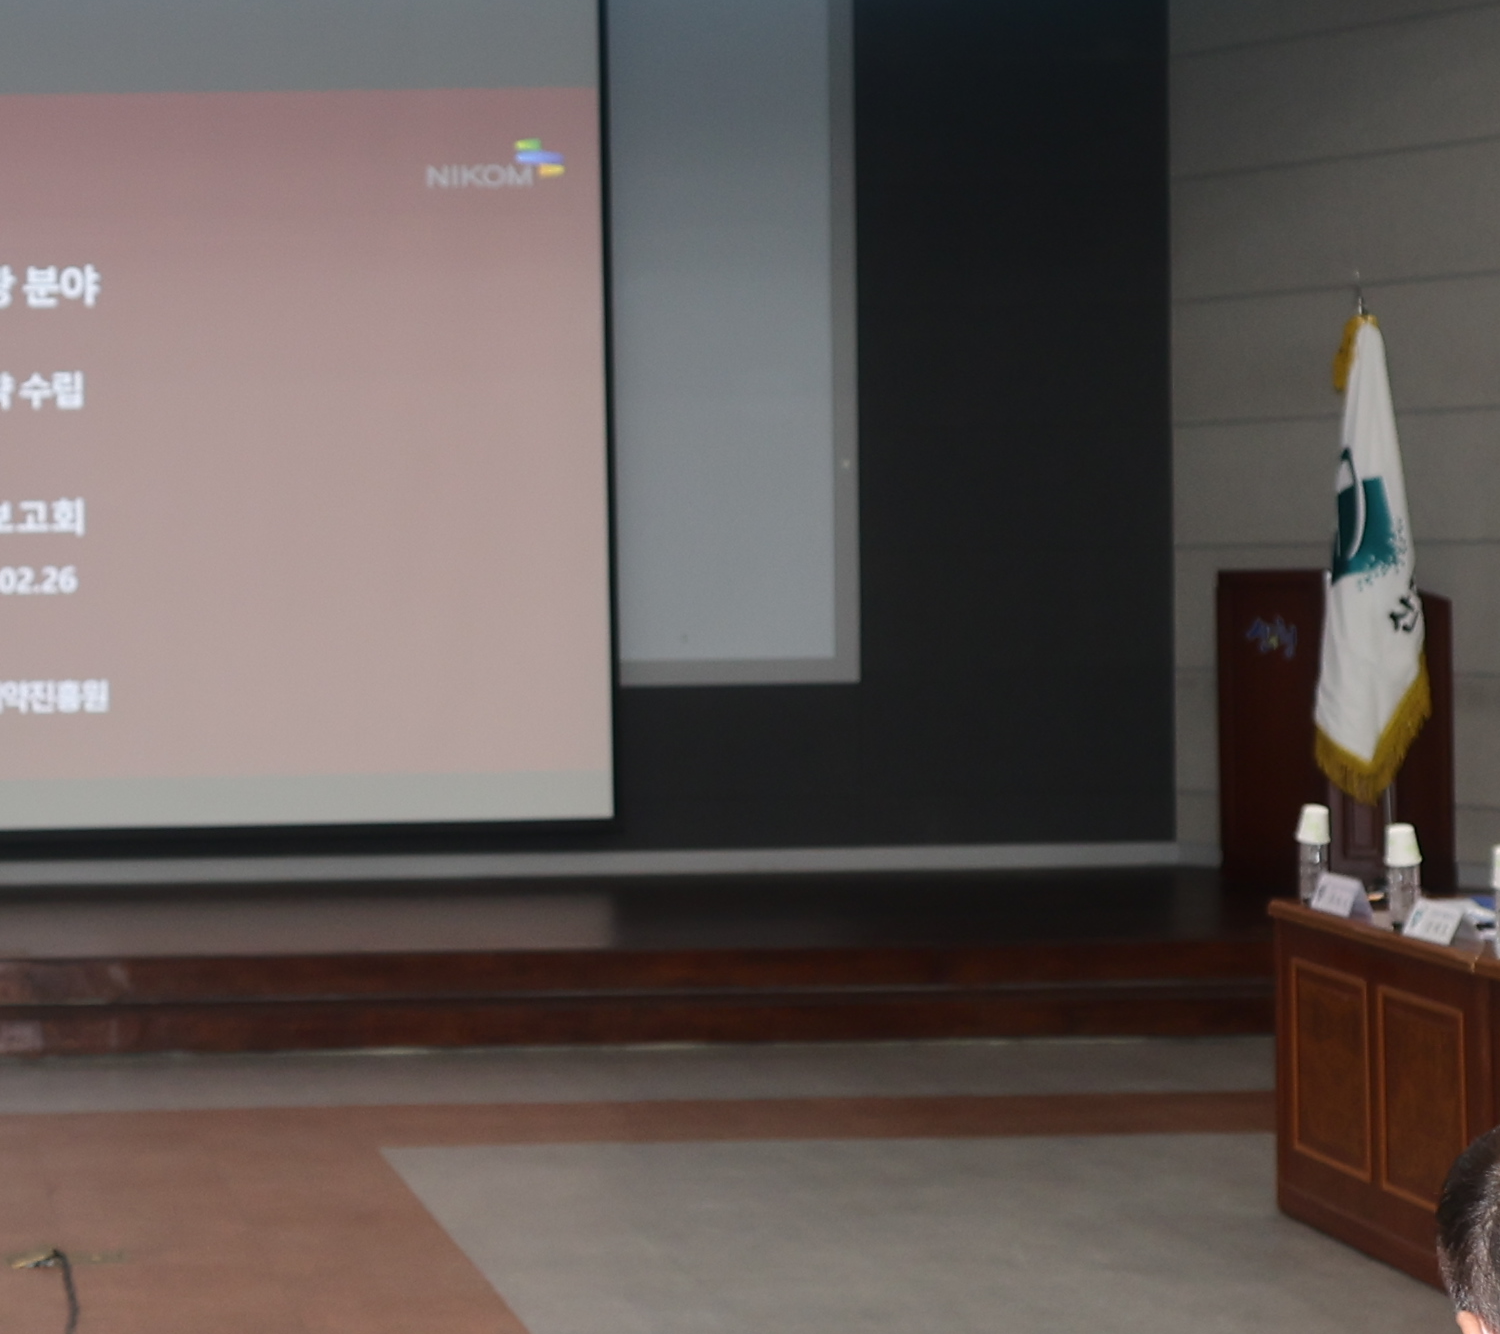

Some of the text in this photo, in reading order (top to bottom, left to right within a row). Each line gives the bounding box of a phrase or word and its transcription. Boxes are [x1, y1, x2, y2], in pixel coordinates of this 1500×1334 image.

[425, 164, 534, 189] NIKOM
[22, 264, 101, 309] 분야
[18, 369, 85, 411] 수립
